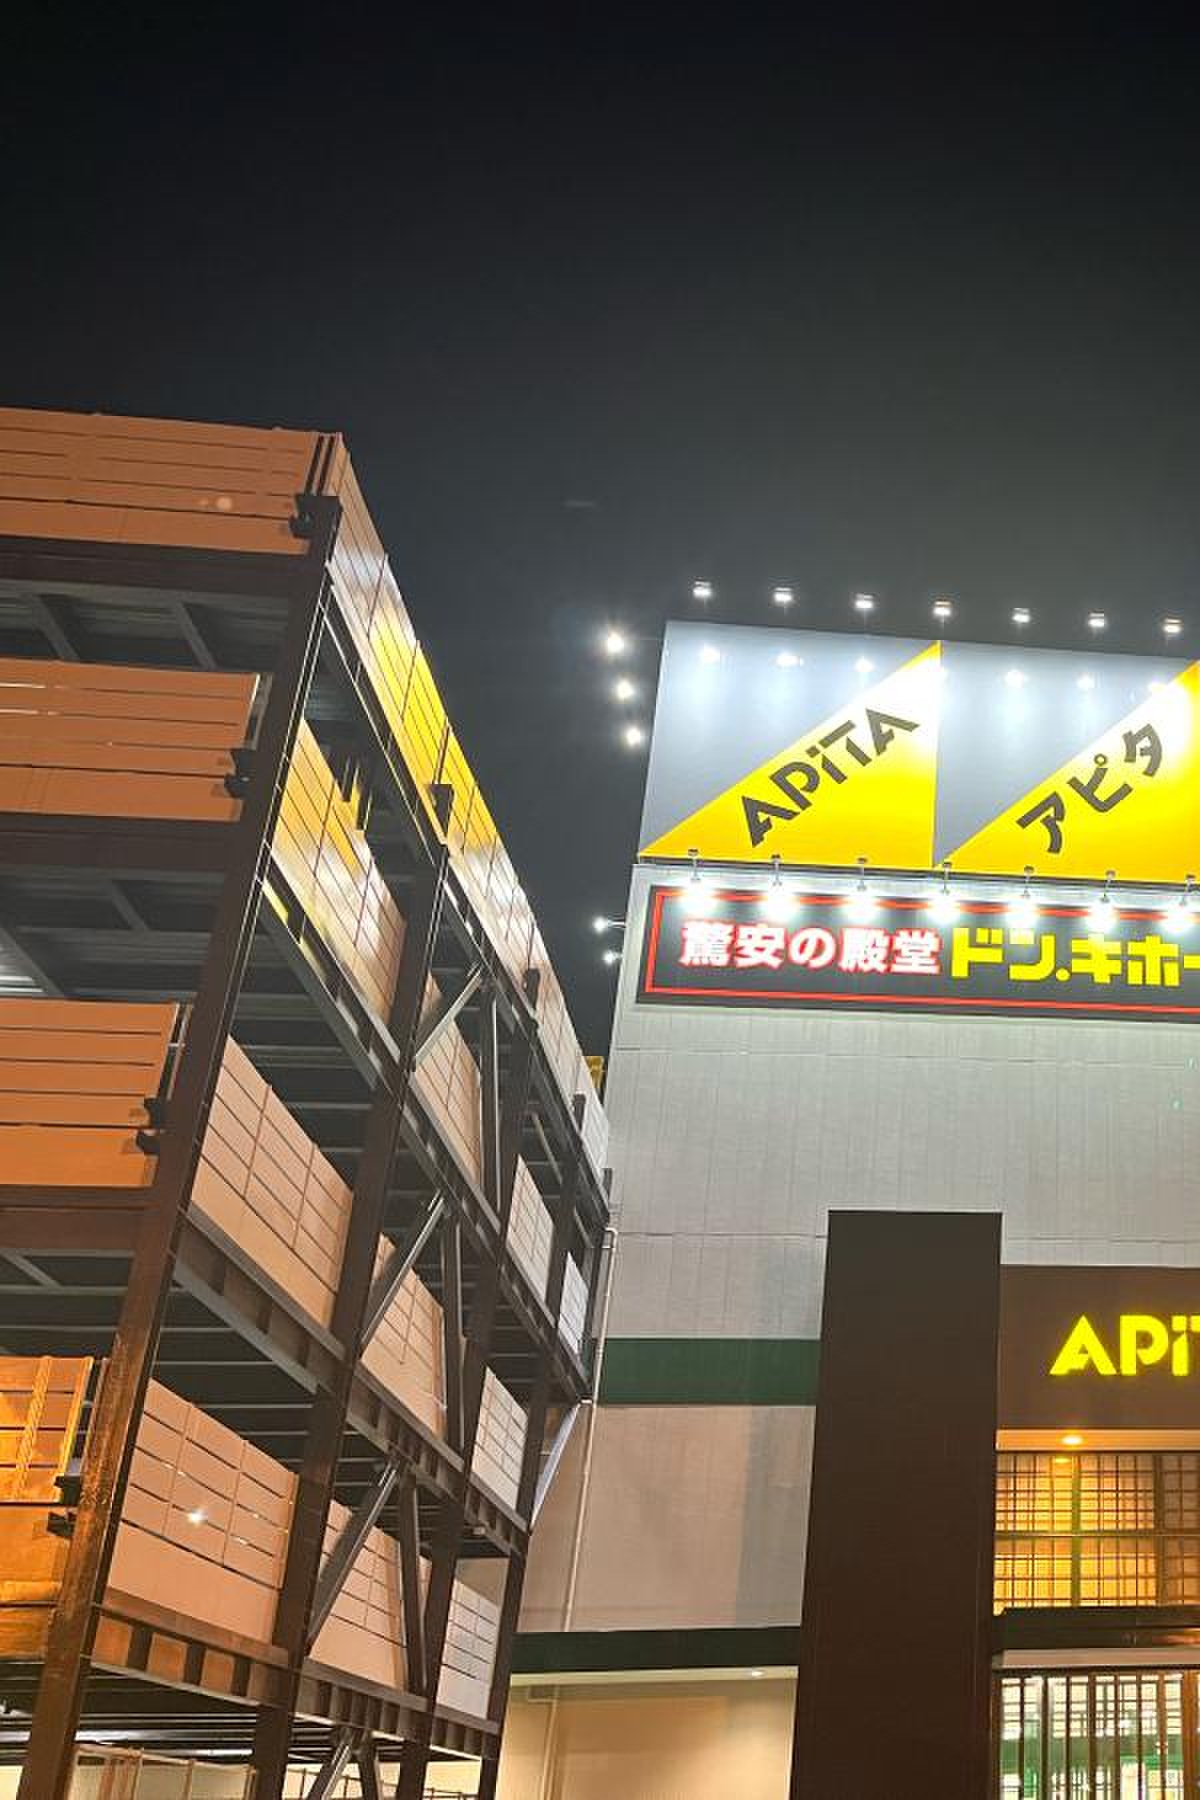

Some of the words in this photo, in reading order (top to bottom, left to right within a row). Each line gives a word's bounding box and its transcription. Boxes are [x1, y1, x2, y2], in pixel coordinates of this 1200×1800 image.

[1016, 722, 1163, 854] アピタ
[680, 920, 942, 975] 驚安の殿堂
